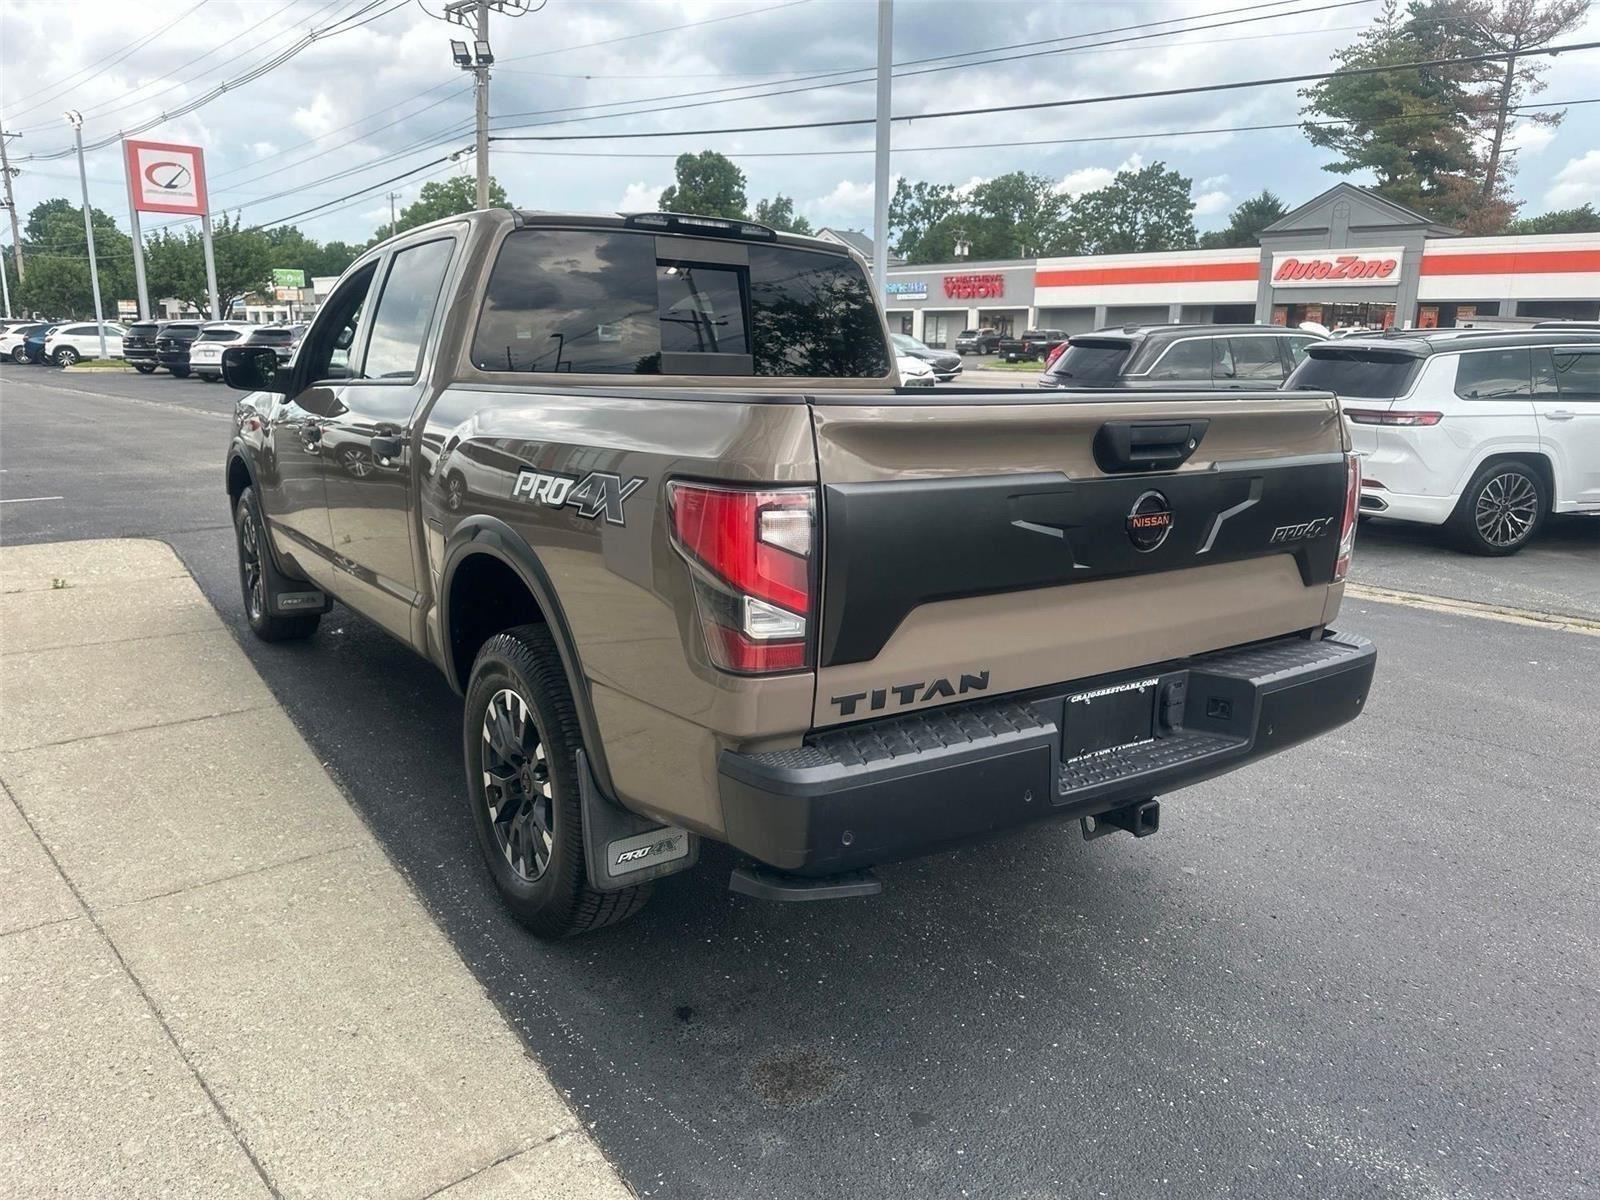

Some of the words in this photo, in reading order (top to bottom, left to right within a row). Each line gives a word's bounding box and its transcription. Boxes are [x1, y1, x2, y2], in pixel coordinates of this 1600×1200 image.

[1274, 256, 1397, 281] AutoZone
[944, 282, 1004, 299] VISION
[1132, 514, 1170, 528] NISSAN
[831, 670, 990, 716] TITAN
